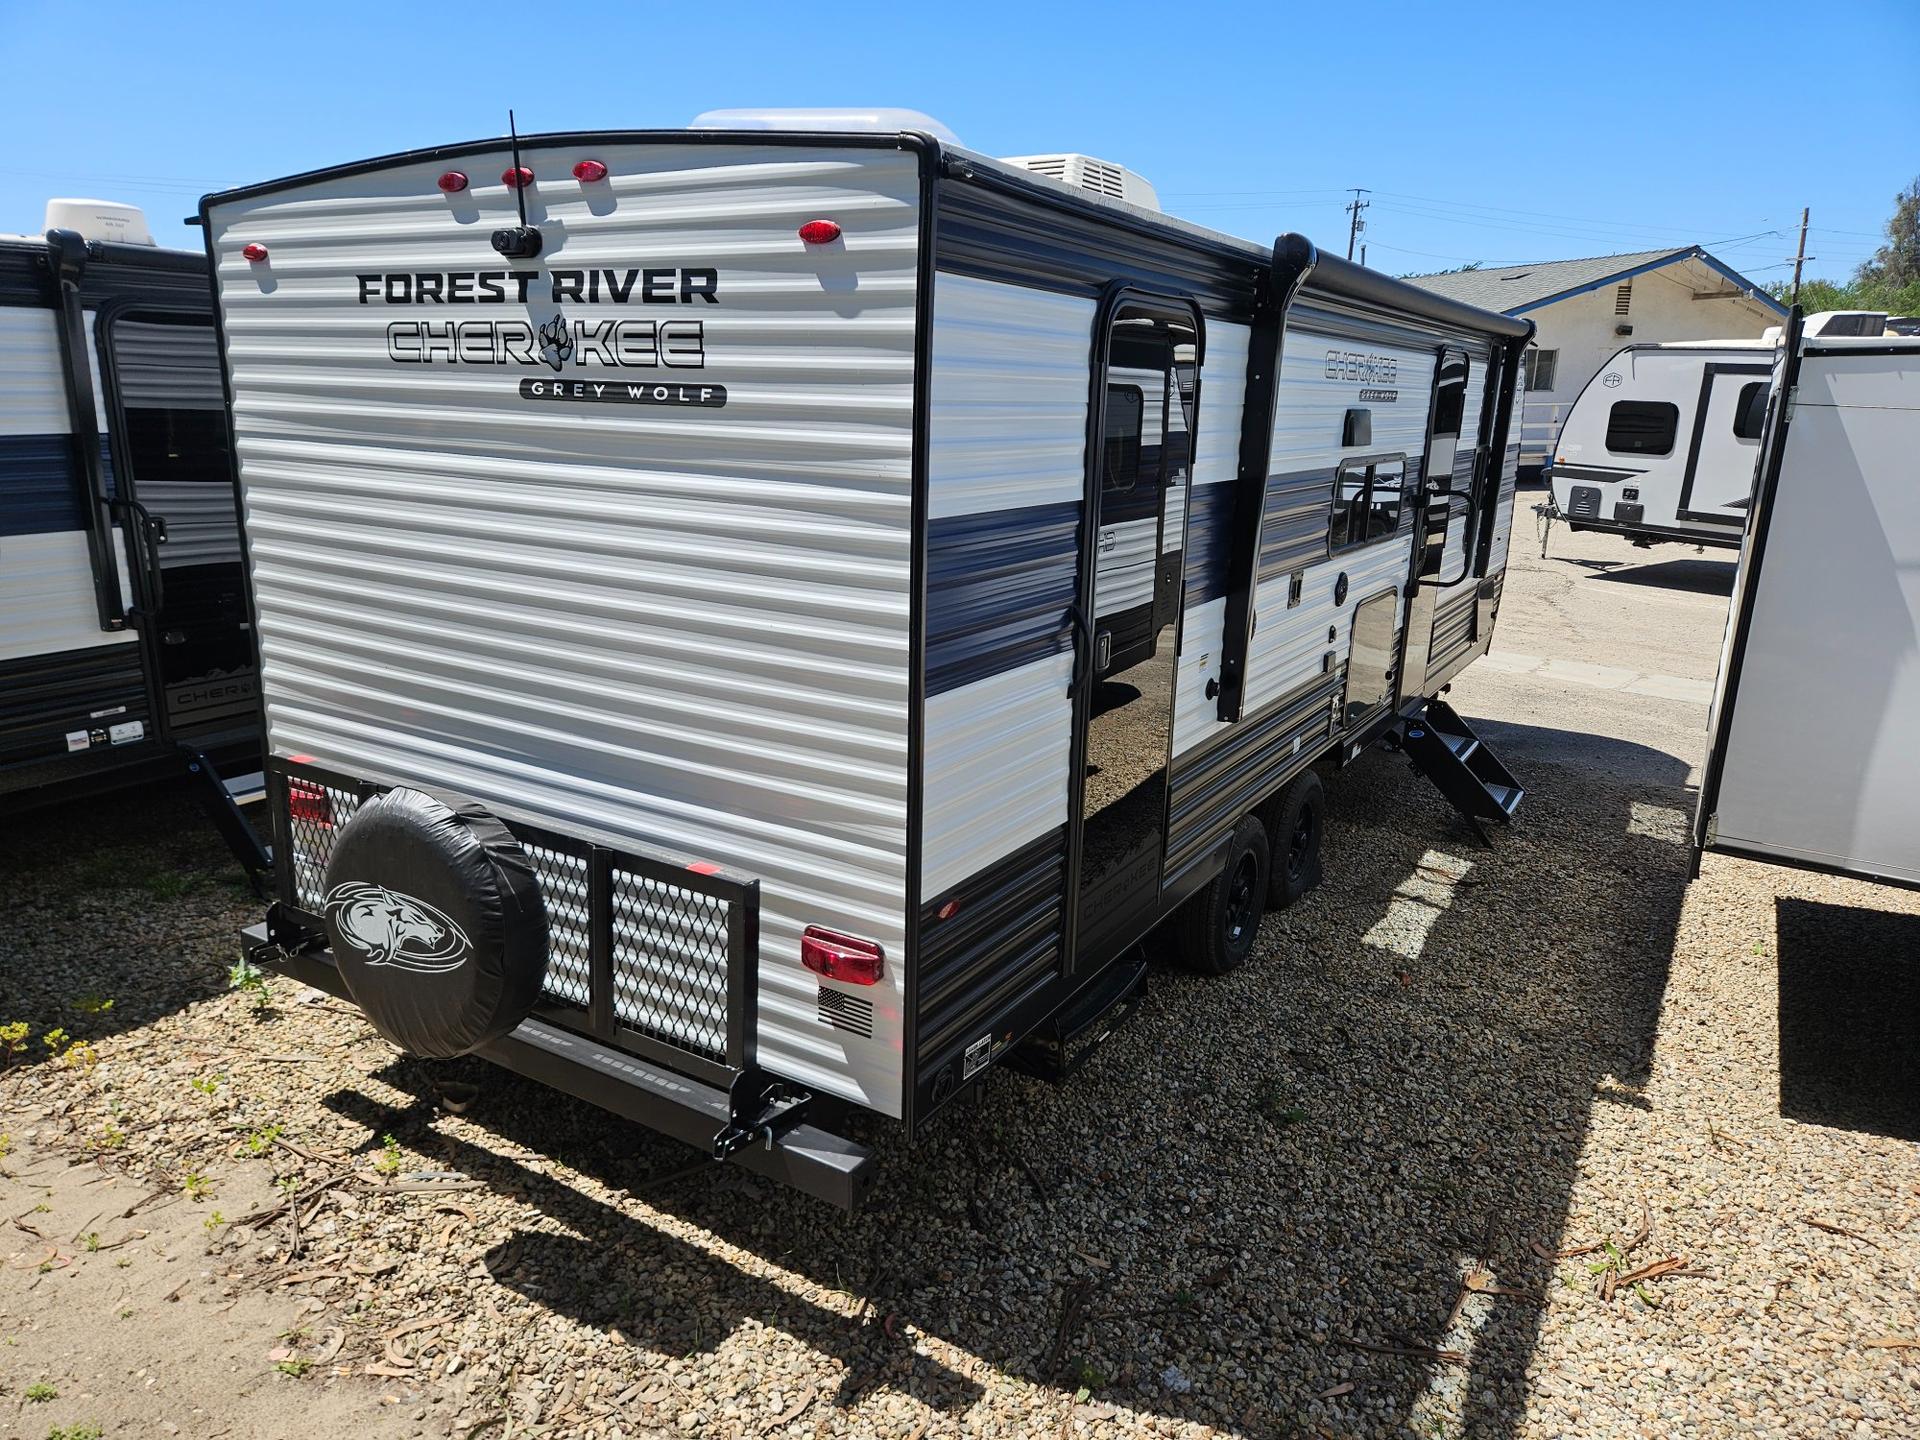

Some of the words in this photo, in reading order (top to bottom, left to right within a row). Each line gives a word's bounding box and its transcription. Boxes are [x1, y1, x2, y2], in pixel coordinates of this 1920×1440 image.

[356, 271, 539, 304] FOREST
[549, 268, 720, 304] RIVER
[531, 381, 606, 399] GREY
[627, 384, 714, 403] WOLF
